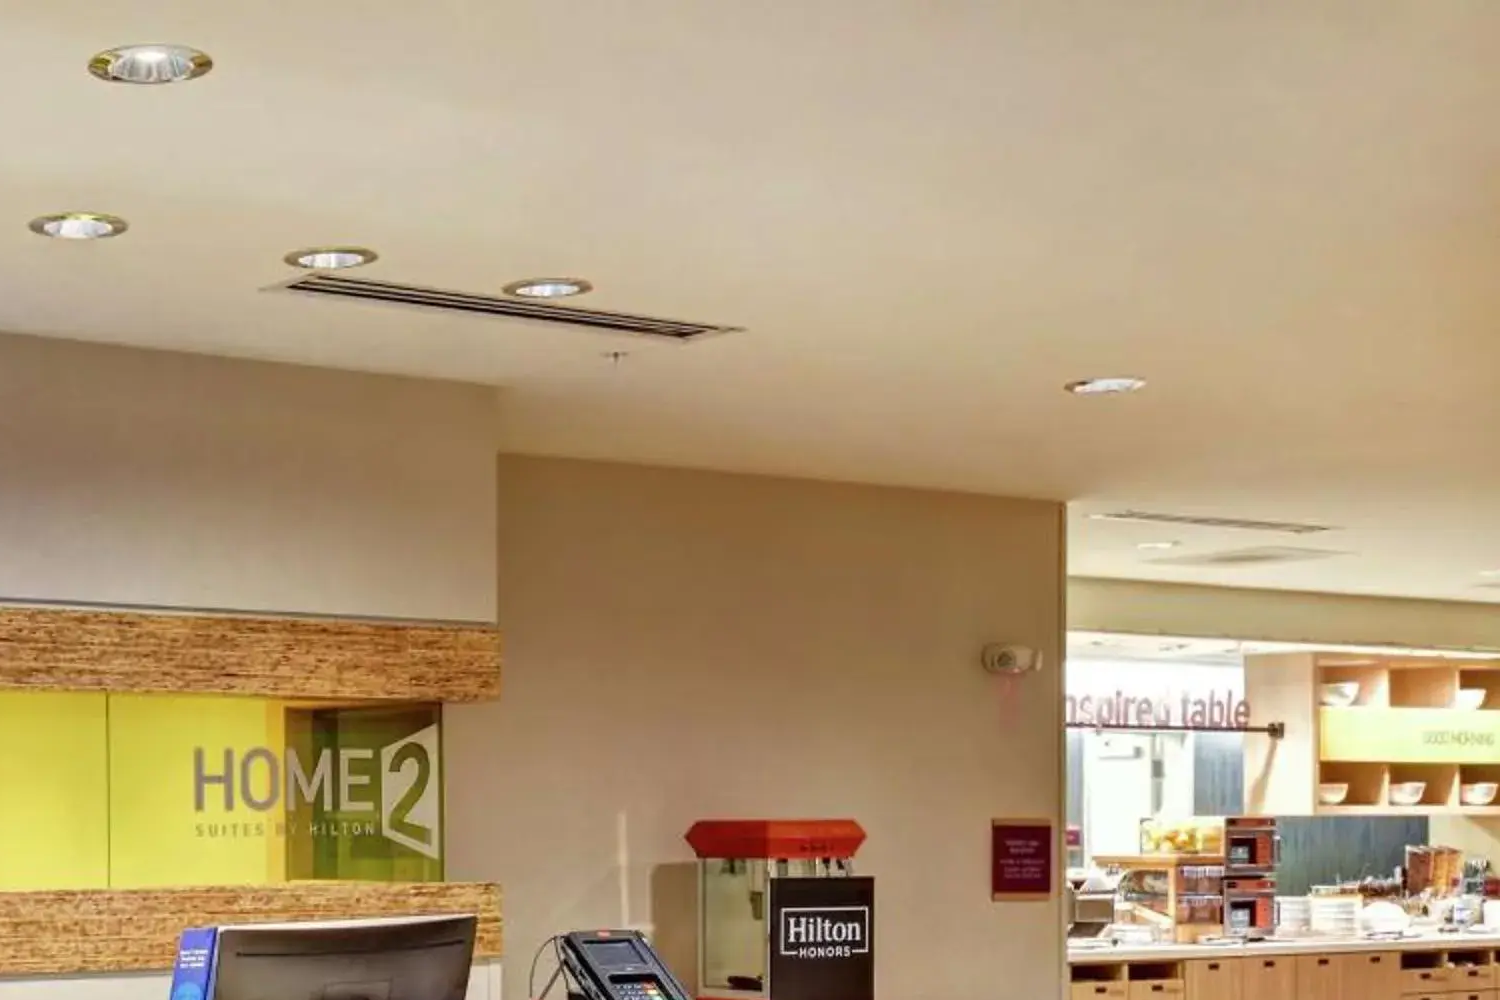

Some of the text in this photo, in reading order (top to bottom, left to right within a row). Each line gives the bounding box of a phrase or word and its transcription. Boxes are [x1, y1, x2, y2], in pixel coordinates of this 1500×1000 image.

[1181, 689, 1251, 729] table
[193, 747, 375, 812] HOME
[194, 821, 376, 838] SUITES BY HILTON
[787, 916, 861, 943] Hilton
[799, 945, 851, 959] HONORS
